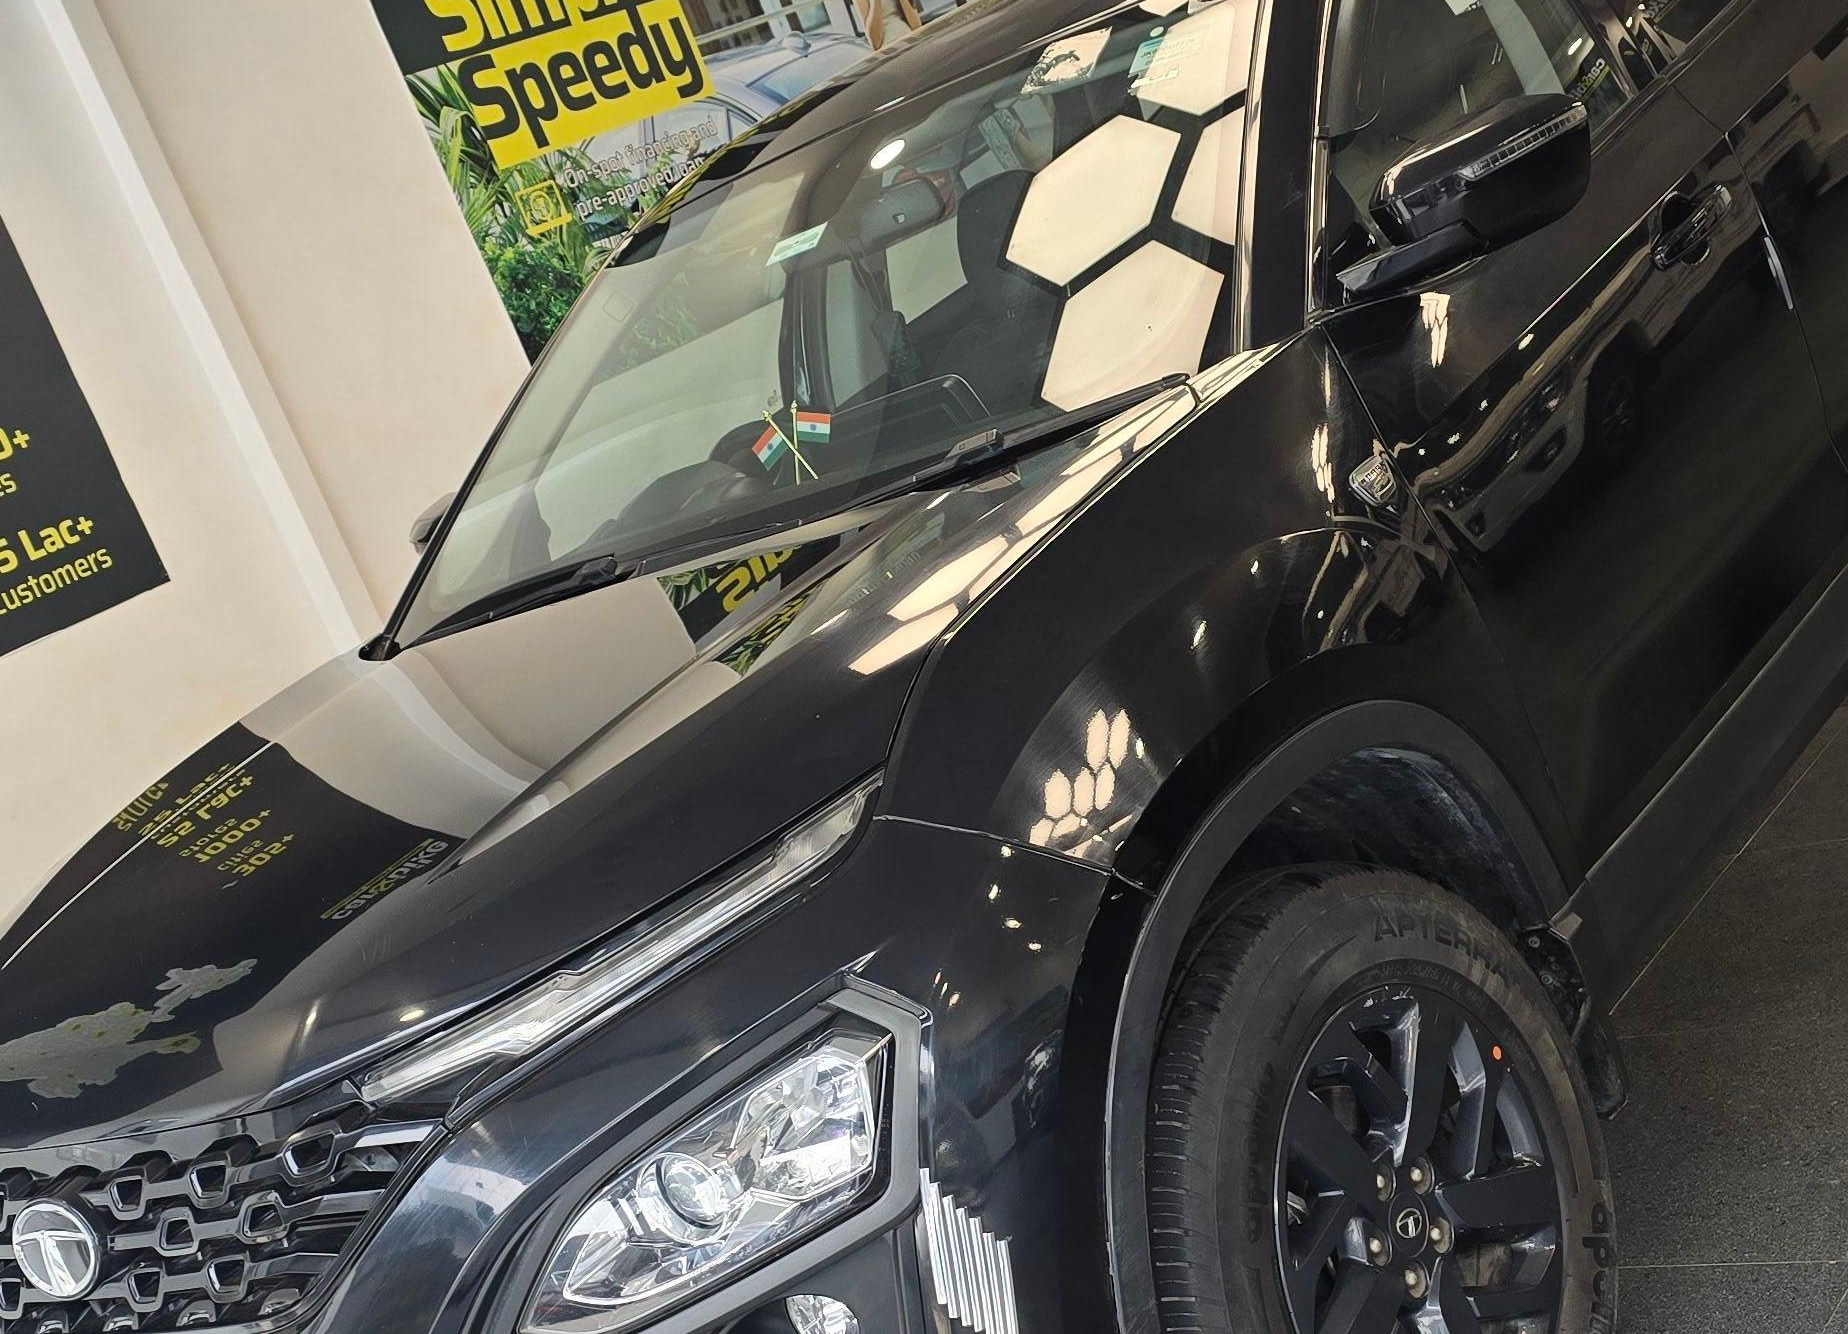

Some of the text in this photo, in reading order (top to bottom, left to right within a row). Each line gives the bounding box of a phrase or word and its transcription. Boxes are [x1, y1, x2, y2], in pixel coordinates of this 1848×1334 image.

[457, 12, 704, 149] Speedy
[563, 115, 719, 188] On-spot financing and
[575, 163, 671, 221] pre-approved
[18, 516, 94, 561] Lac+
